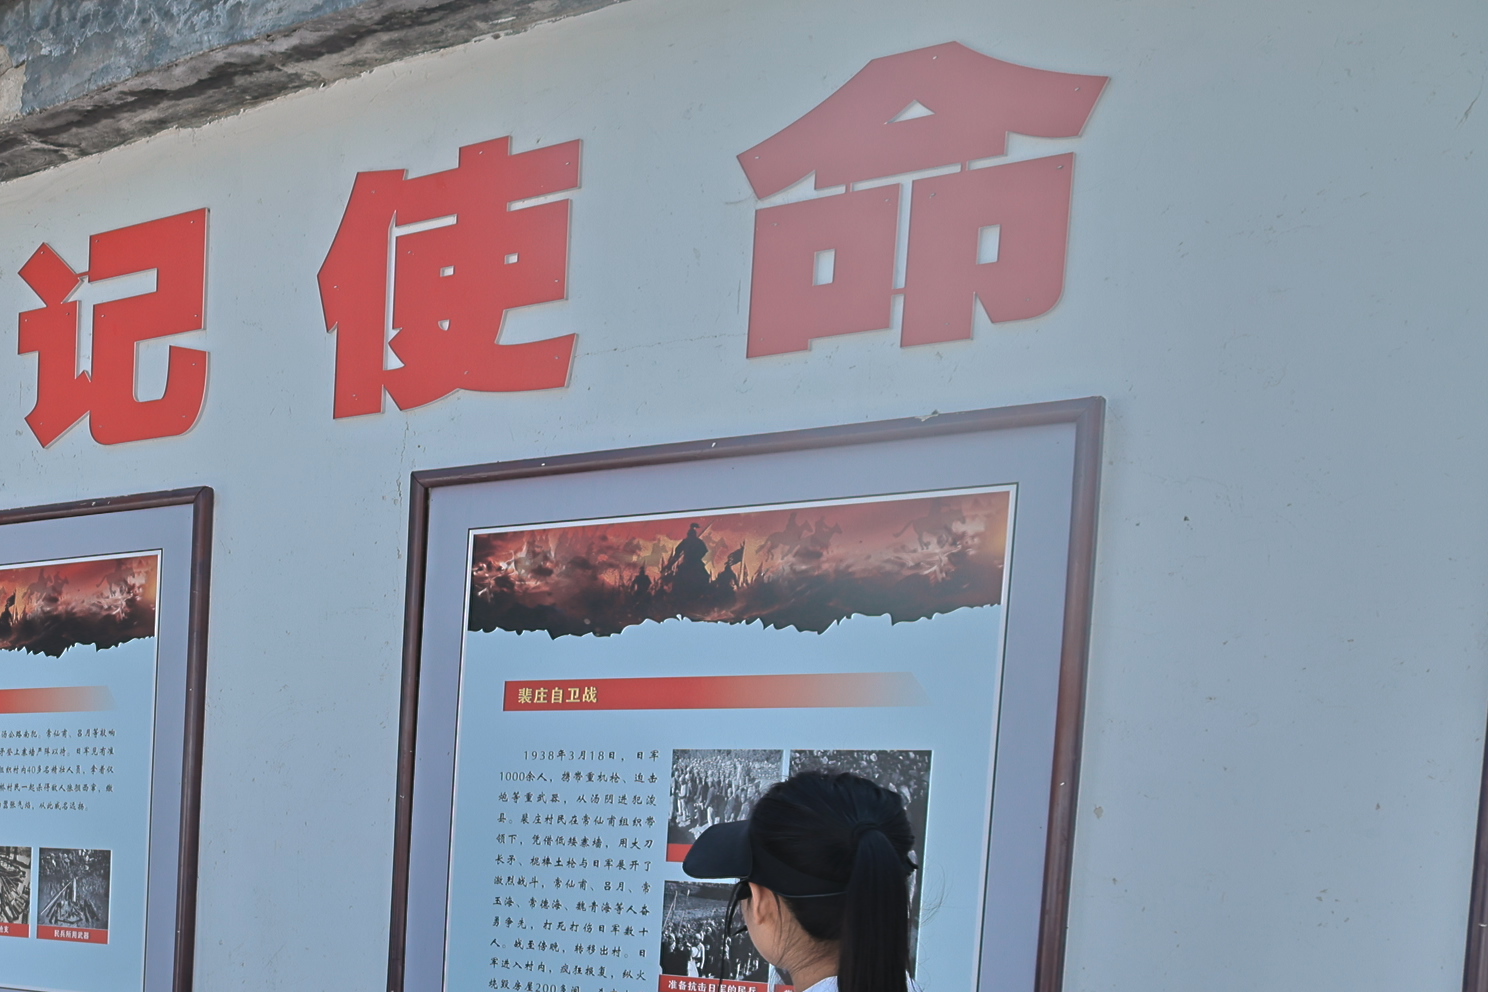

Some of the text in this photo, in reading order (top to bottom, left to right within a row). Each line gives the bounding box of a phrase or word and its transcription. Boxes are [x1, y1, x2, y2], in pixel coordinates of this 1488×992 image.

[518, 686, 597, 704] 裴庄自卫战
